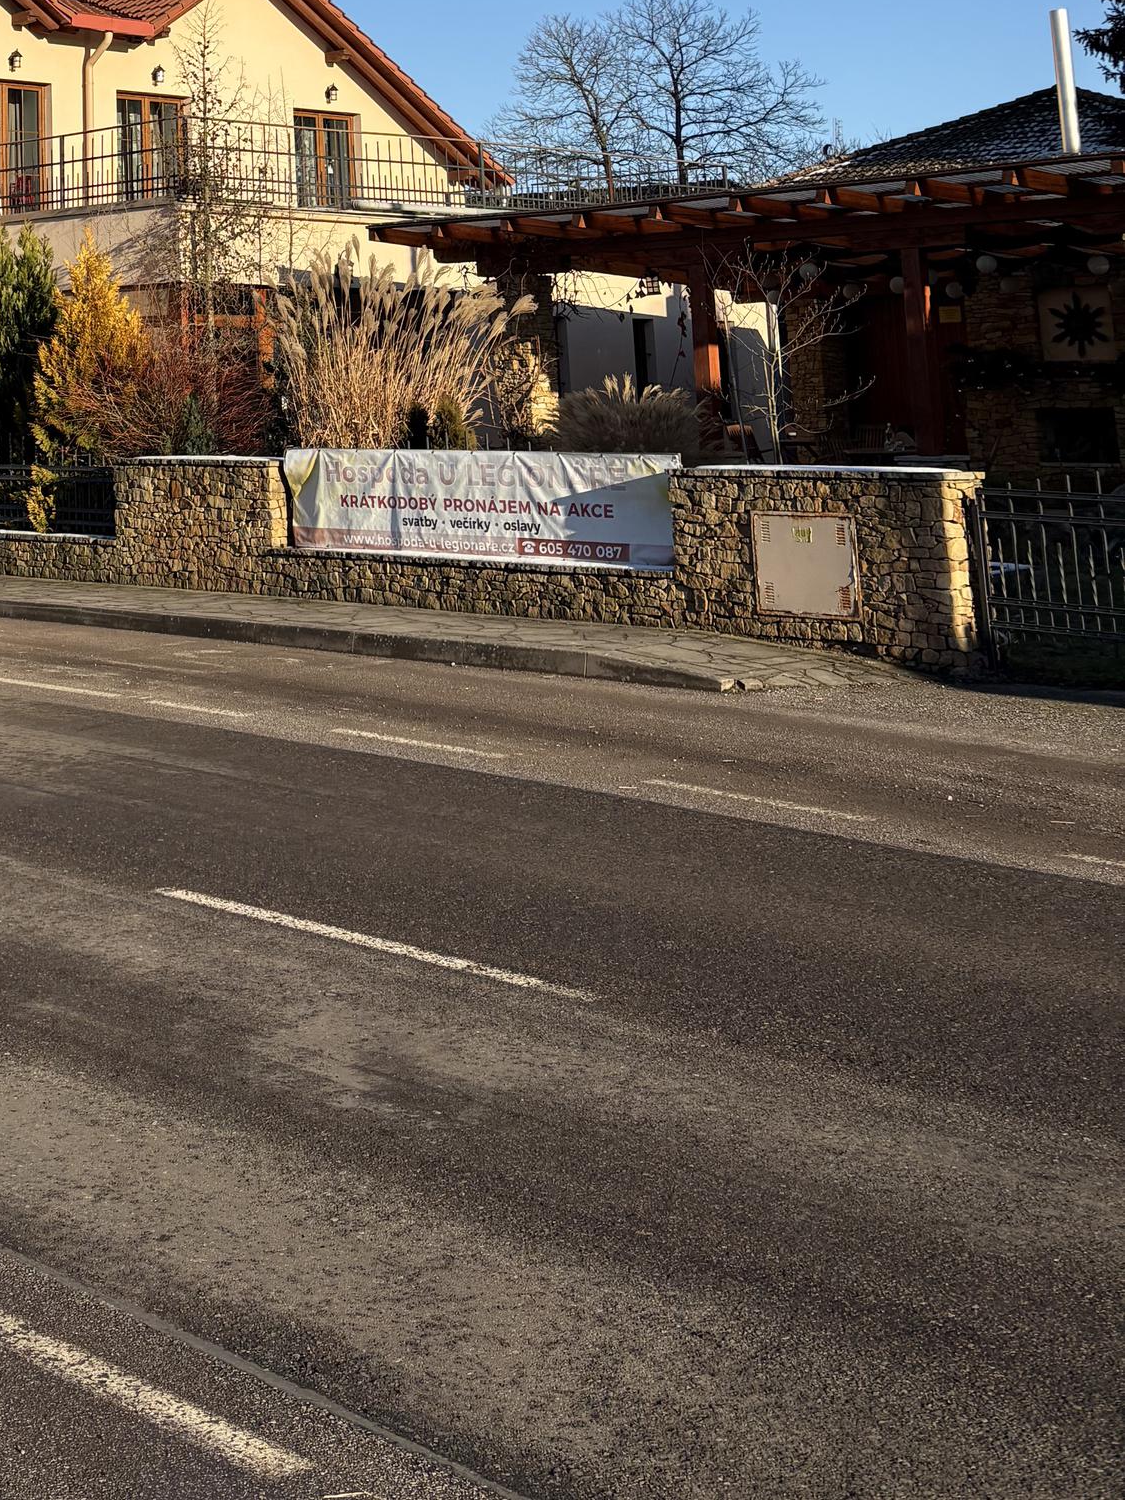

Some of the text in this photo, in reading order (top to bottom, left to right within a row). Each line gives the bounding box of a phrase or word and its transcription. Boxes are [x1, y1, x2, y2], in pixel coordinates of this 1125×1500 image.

[325, 461, 429, 488] Hospoda
[439, 461, 456, 486] U
[340, 492, 614, 518] KRÁTKODOBÝ PRONÁJEM NA AKCE
[402, 515, 541, 535] svatby večírky oslavy
[539, 542, 622, 559] 605 470 087
